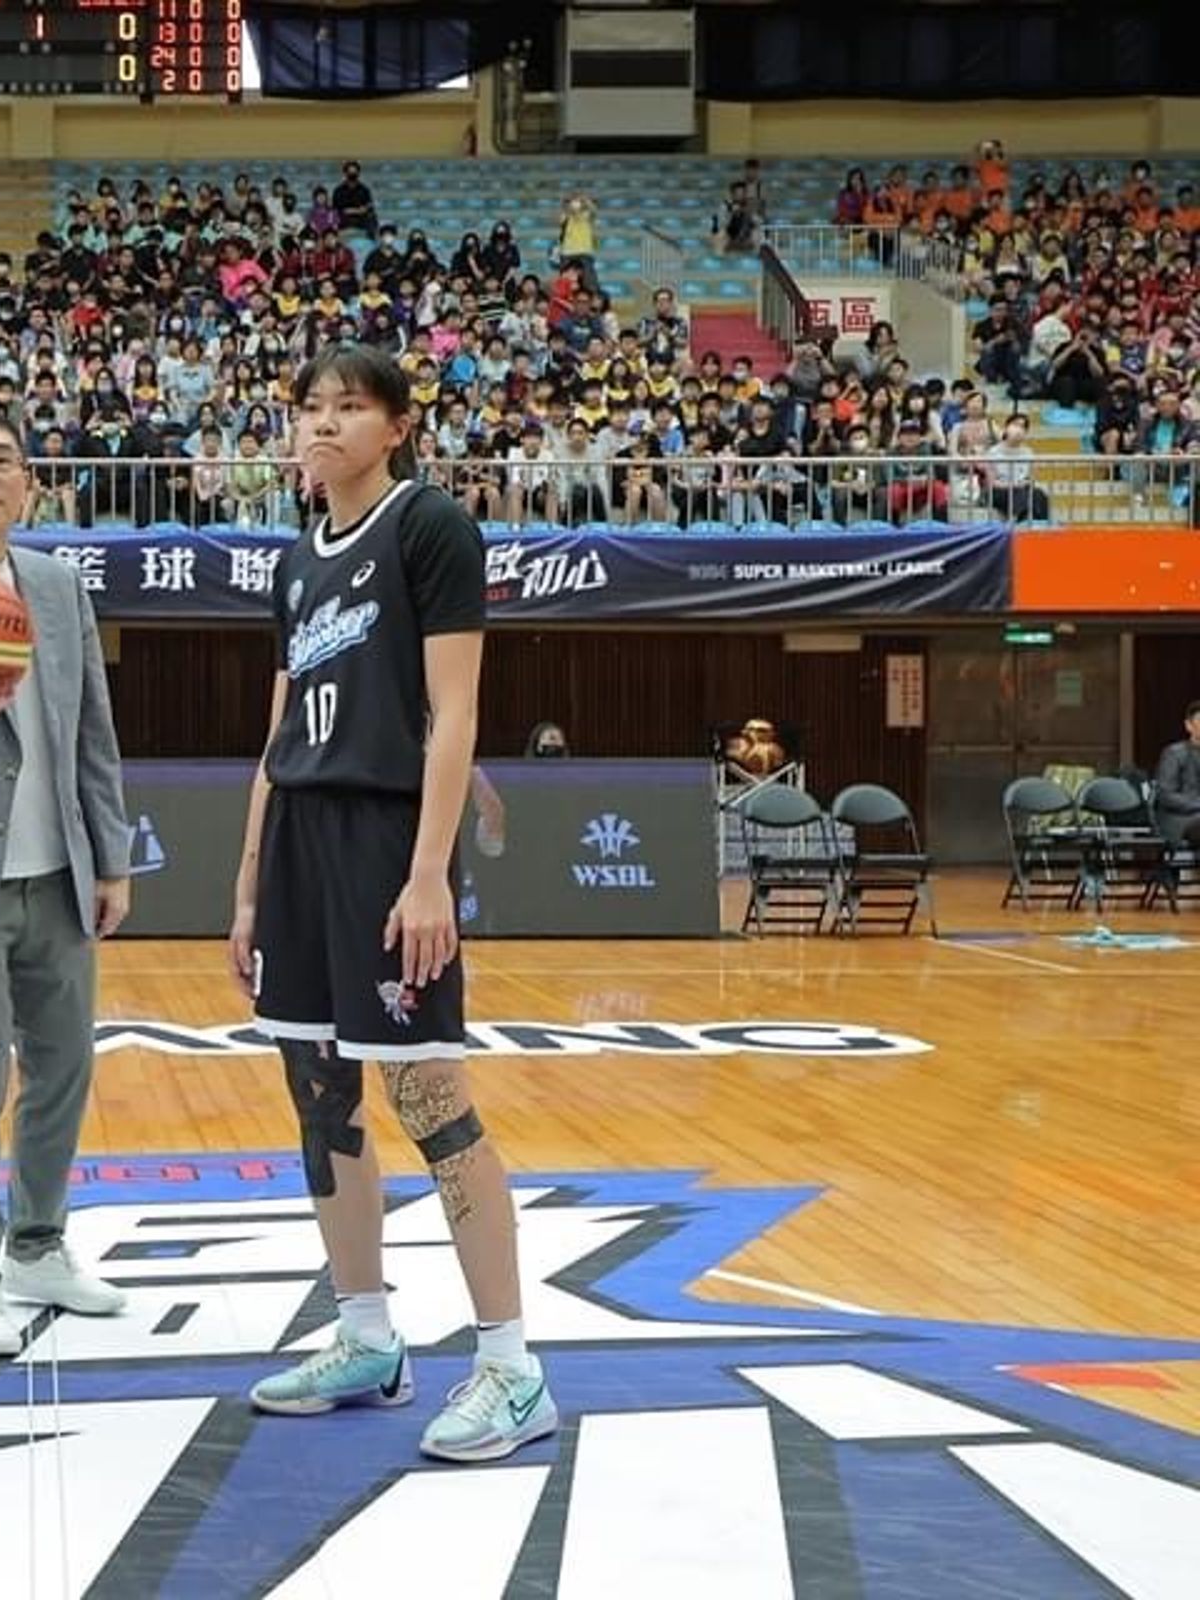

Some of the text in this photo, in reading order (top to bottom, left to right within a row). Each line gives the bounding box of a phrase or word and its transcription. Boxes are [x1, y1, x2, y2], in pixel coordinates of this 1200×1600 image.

[119, 13, 136, 41] 0
[159, 22, 240, 43] 13 0 0
[151, 46, 240, 67] 24 0 0
[119, 54, 136, 82] 0
[162, 70, 176, 91] 2
[189, 70, 202, 91] 0
[227, 70, 240, 91] 0
[734, 564, 784, 580] SUPER
[304, 682, 338, 747] 10
